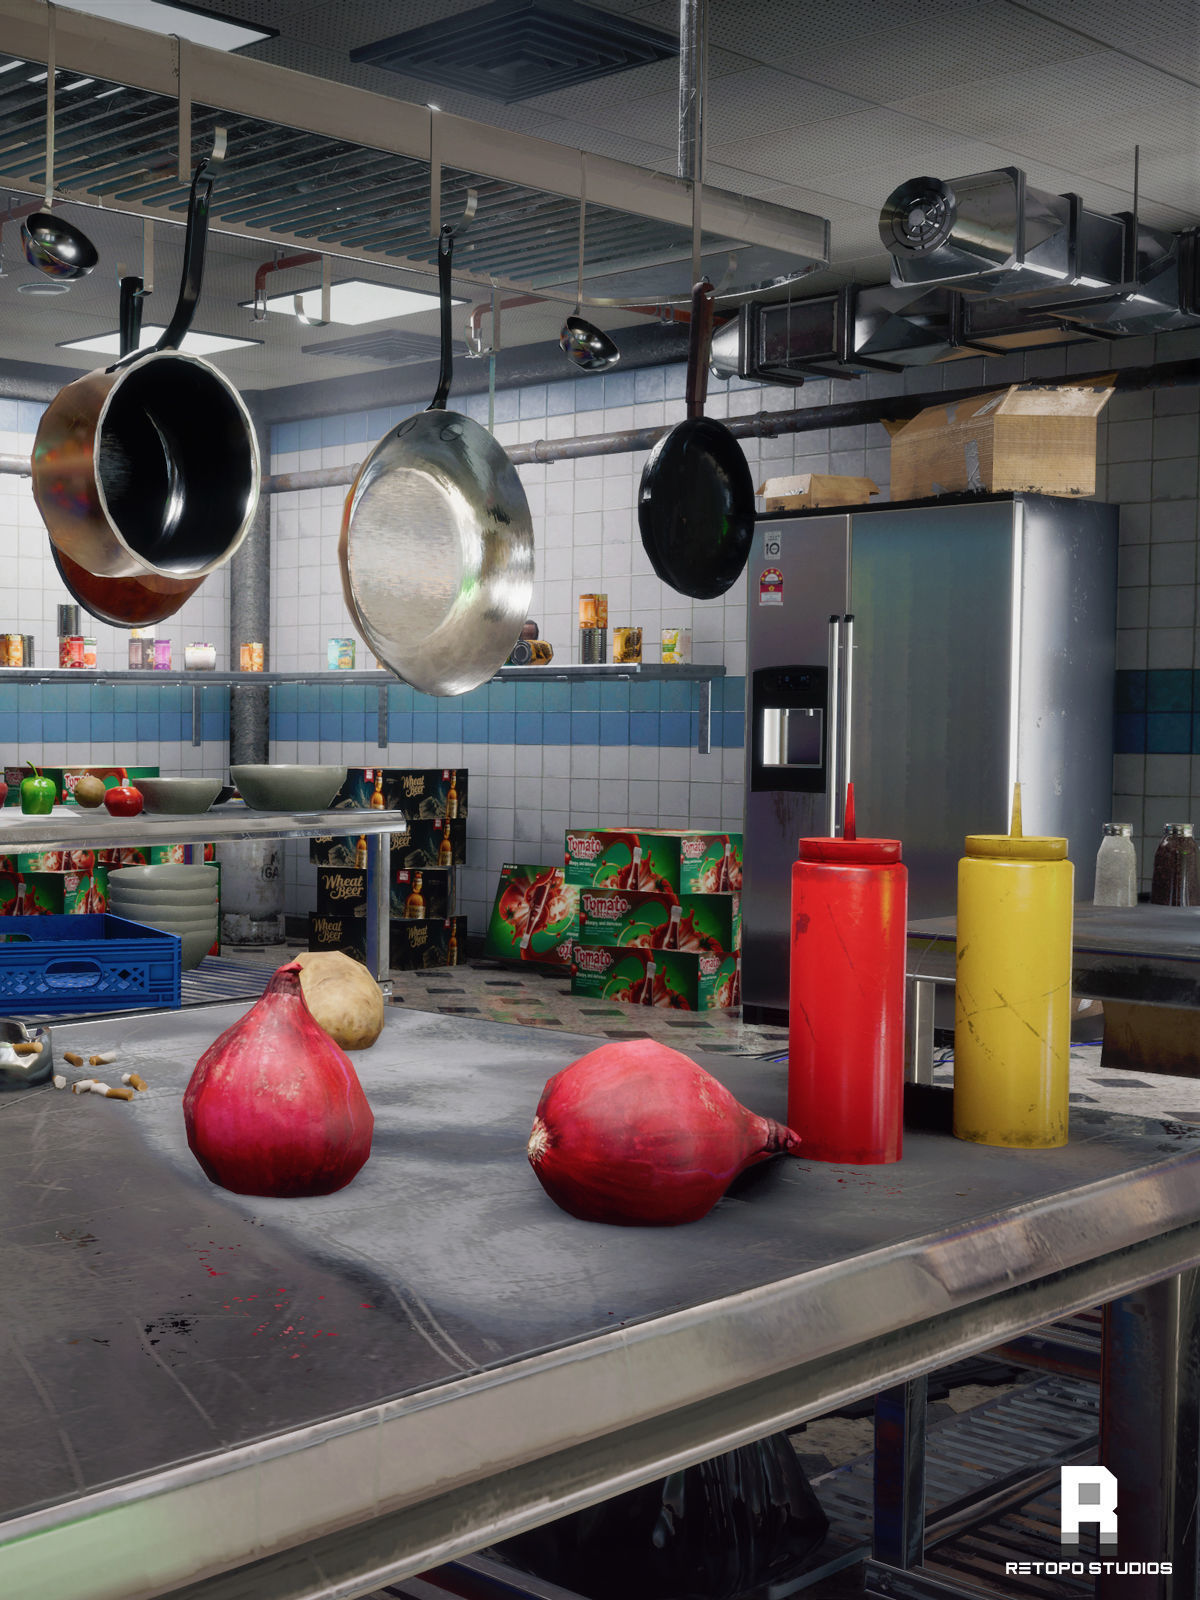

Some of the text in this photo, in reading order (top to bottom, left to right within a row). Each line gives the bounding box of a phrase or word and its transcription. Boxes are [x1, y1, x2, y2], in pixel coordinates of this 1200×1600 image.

[401, 775, 425, 789] Wheat
[406, 785, 426, 798] Beer
[567, 835, 602, 854] Tomato
[322, 874, 363, 889] Wheat
[330, 886, 364, 899] Beer
[582, 894, 628, 913] Tomato
[312, 918, 342, 932] Wheat
[318, 930, 342, 943] Beer
[573, 946, 611, 967] Tomato
